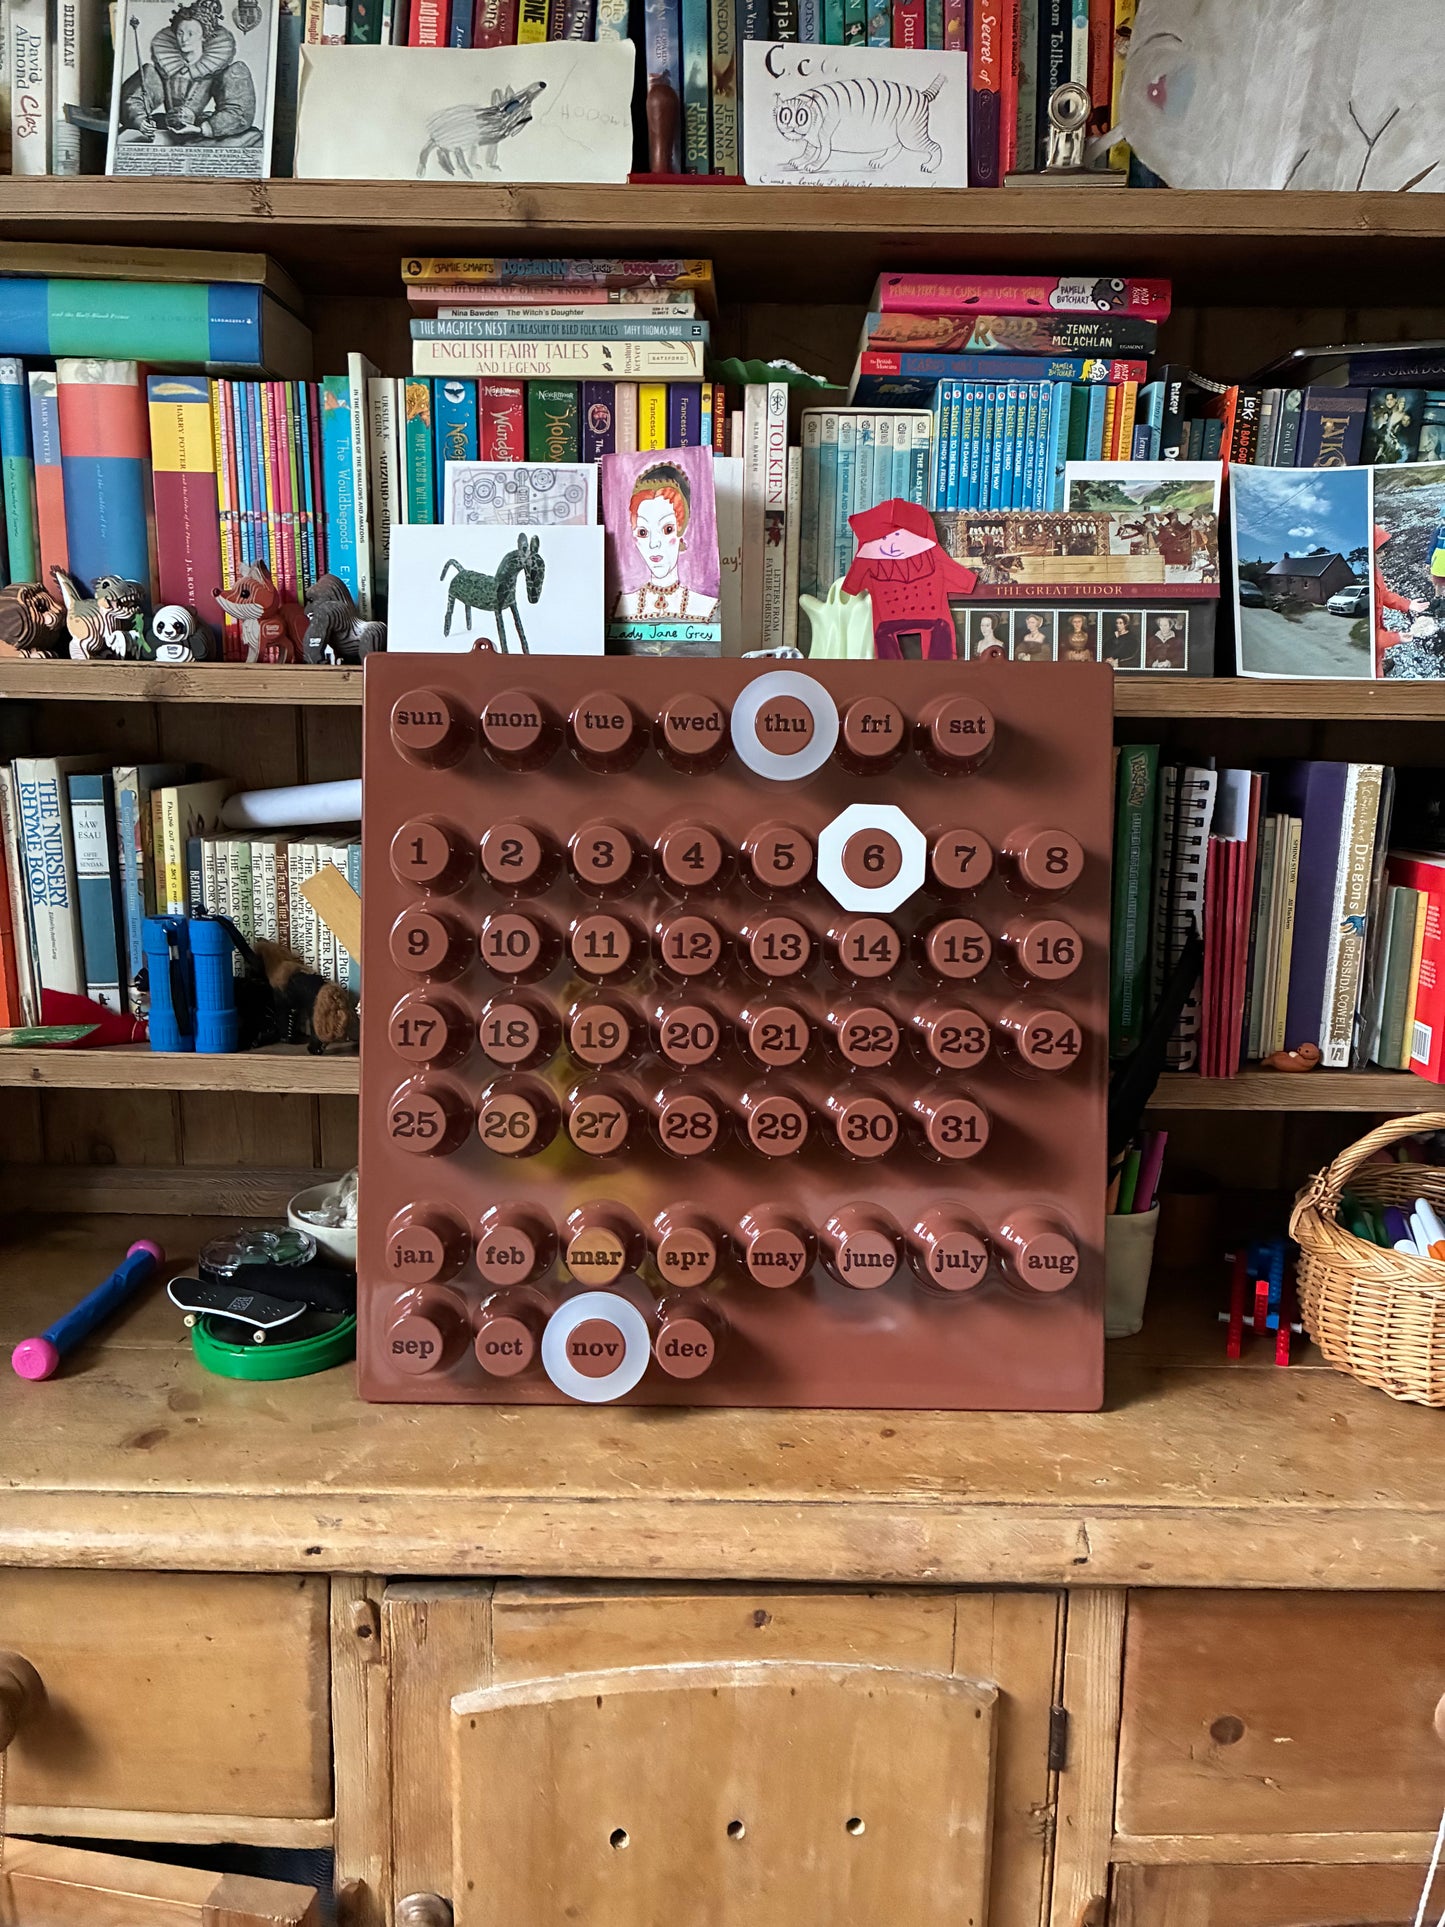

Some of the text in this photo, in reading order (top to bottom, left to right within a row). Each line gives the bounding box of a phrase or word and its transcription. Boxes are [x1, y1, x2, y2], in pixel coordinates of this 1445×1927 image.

[63, 4, 75, 69] BIRDMAN
[981, 12, 996, 64] Secret
[16, 25, 42, 139] David Almond Clay
[979, 70, 991, 85] of
[687, 103, 698, 161] NIMMO
[696, 103, 708, 160] JENNY
[715, 104, 725, 161] NIMMO
[725, 105, 734, 160] JENNY
[1057, 295, 1090, 304] BUTCHART
[1060, 286, 1085, 295] PAMELA
[420, 321, 435, 335] THE
[437, 321, 482, 335] MAGPIE'S
[485, 321, 508, 335] NEST
[509, 324, 515, 334] A
[517, 324, 550, 335] TREASURY
[551, 324, 560, 335] OF
[562, 324, 579, 335] BIRD
[580, 324, 599, 335] FOLK
[600, 324, 619, 335] TALES
[624, 325, 641, 335] TAFFY
[642, 325, 668, 336] THOMAS
[551, 309, 584, 317] Daughter
[1066, 324, 1099, 334] JENNY
[432, 343, 589, 359] ENGLISH FAIRY TALES
[1052, 336, 1112, 347] MCLACHLAN
[476, 362, 552, 374] AND LEGENDS
[1052, 362, 1073, 370] PAMELA
[40, 398, 51, 463] HARRY POTTER
[374, 401, 383, 437] LE GUIN
[381, 395, 389, 431] URSULA
[650, 399, 658, 437] Francesca
[680, 397, 689, 437] Francesca
[716, 392, 725, 448] Early Reader
[176, 405, 187, 469] HARRY POTTER
[1238, 427, 1250, 464] BAD GOD
[1283, 423, 1295, 454] Smith
[415, 434, 427, 504] HAVE SWORD WILL
[768, 420, 784, 505] TOLKIEN
[916, 452, 924, 469] THE
[336, 437, 352, 550] The Wouldbegoods
[358, 516, 366, 543] AMAZONS
[764, 558, 773, 642] FATHER CHRISTMAS
[772, 569, 781, 632] LETTERS FROM
[994, 585, 1123, 596] THE GREAT TUDOR
[606, 623, 713, 641] Lady Jane Grey
[397, 711, 986, 734] sun mon tue wed thu fri sat
[78, 831, 101, 840] ESAU
[79, 821, 99, 829] SAW
[20, 781, 48, 907] RHYME BOOK
[38, 779, 69, 909] THE NURSERY
[410, 837, 1069, 874] 1 2 3 4 5 6 7 8
[1289, 839, 1299, 884] SPRING STORY
[217, 855, 228, 903] THE TALE
[265, 853, 275, 915] THE TALE OF
[304, 856, 314, 875] THE
[1349, 844, 1368, 911] Dragons
[207, 874, 216, 904] STORY
[230, 851, 241, 928] THE TAILOR OF
[240, 864, 251, 926] THE TALE OF
[252, 853, 264, 927] THE TALE OF MR
[276, 853, 290, 936] THE TALE OF THE PIE
[291, 900, 300, 950] OF JOHNNY
[305, 902, 315, 952] OF JEMIMA
[323, 924, 332, 953] PETER
[407, 928, 1075, 965] 9 10 11 12 13 14 15 16
[1334, 938, 1355, 1037] CRESSIDA COWELL
[397, 1019, 1078, 1055] 17 18 19 20 21 22 23 24
[392, 1110, 982, 1143] 25 26 27 28 29 30 31
[393, 1245, 1076, 1274] jan feb mar apr may june july aug
[392, 1337, 708, 1359] sep oct nov dec
